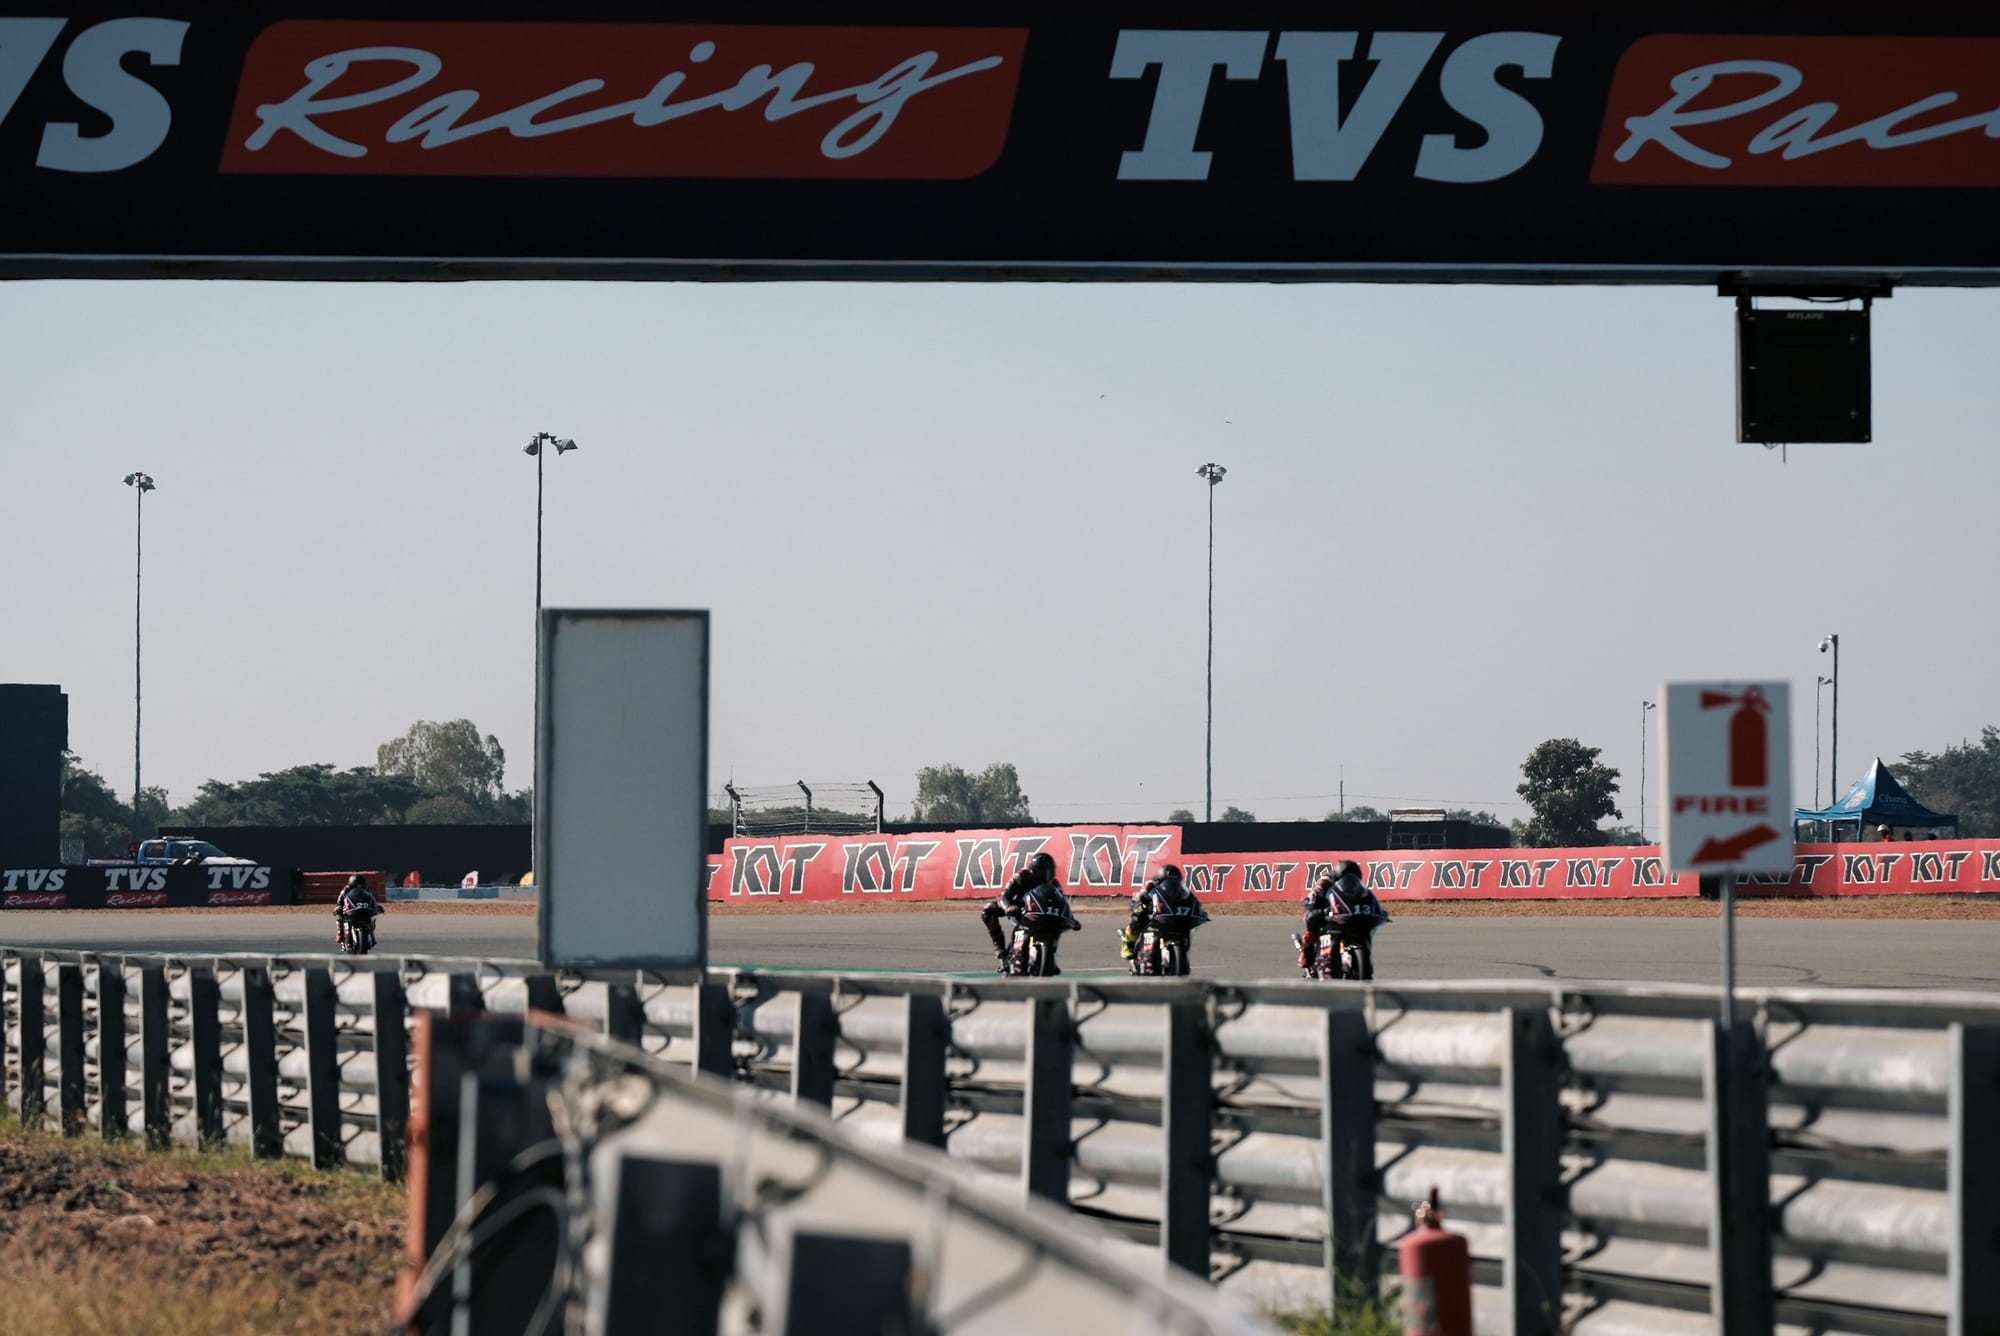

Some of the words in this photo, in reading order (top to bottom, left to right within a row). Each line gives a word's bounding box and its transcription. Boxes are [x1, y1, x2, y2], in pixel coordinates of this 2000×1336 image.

[244, 41, 1003, 159] Racing
[1108, 29, 1561, 183] TVS
[1613, 60, 2000, 169] Rac
[1674, 794, 1769, 815] FIRE
[730, 843, 828, 896] KYT
[842, 840, 943, 893] KYT
[1067, 833, 1173, 887] KYT
[1366, 860, 1426, 889] KYT
[1430, 859, 1493, 888] KYT
[1498, 858, 1560, 888] KYT
[1565, 857, 1625, 887] KYT
[1842, 853, 1905, 884] KYT
[1910, 851, 1973, 883] KYT
[3, 868, 66, 892] TVS
[105, 867, 168, 891] TVS
[207, 866, 271, 889] TVS
[1183, 864, 1237, 893] KYT
[1243, 862, 1300, 891] KYT
[3, 894, 66, 906] Racing
[106, 892, 168, 905] Racing
[208, 891, 271, 904] Racing
[1175, 906, 1191, 916] 17
[1354, 904, 1371, 915] 13
